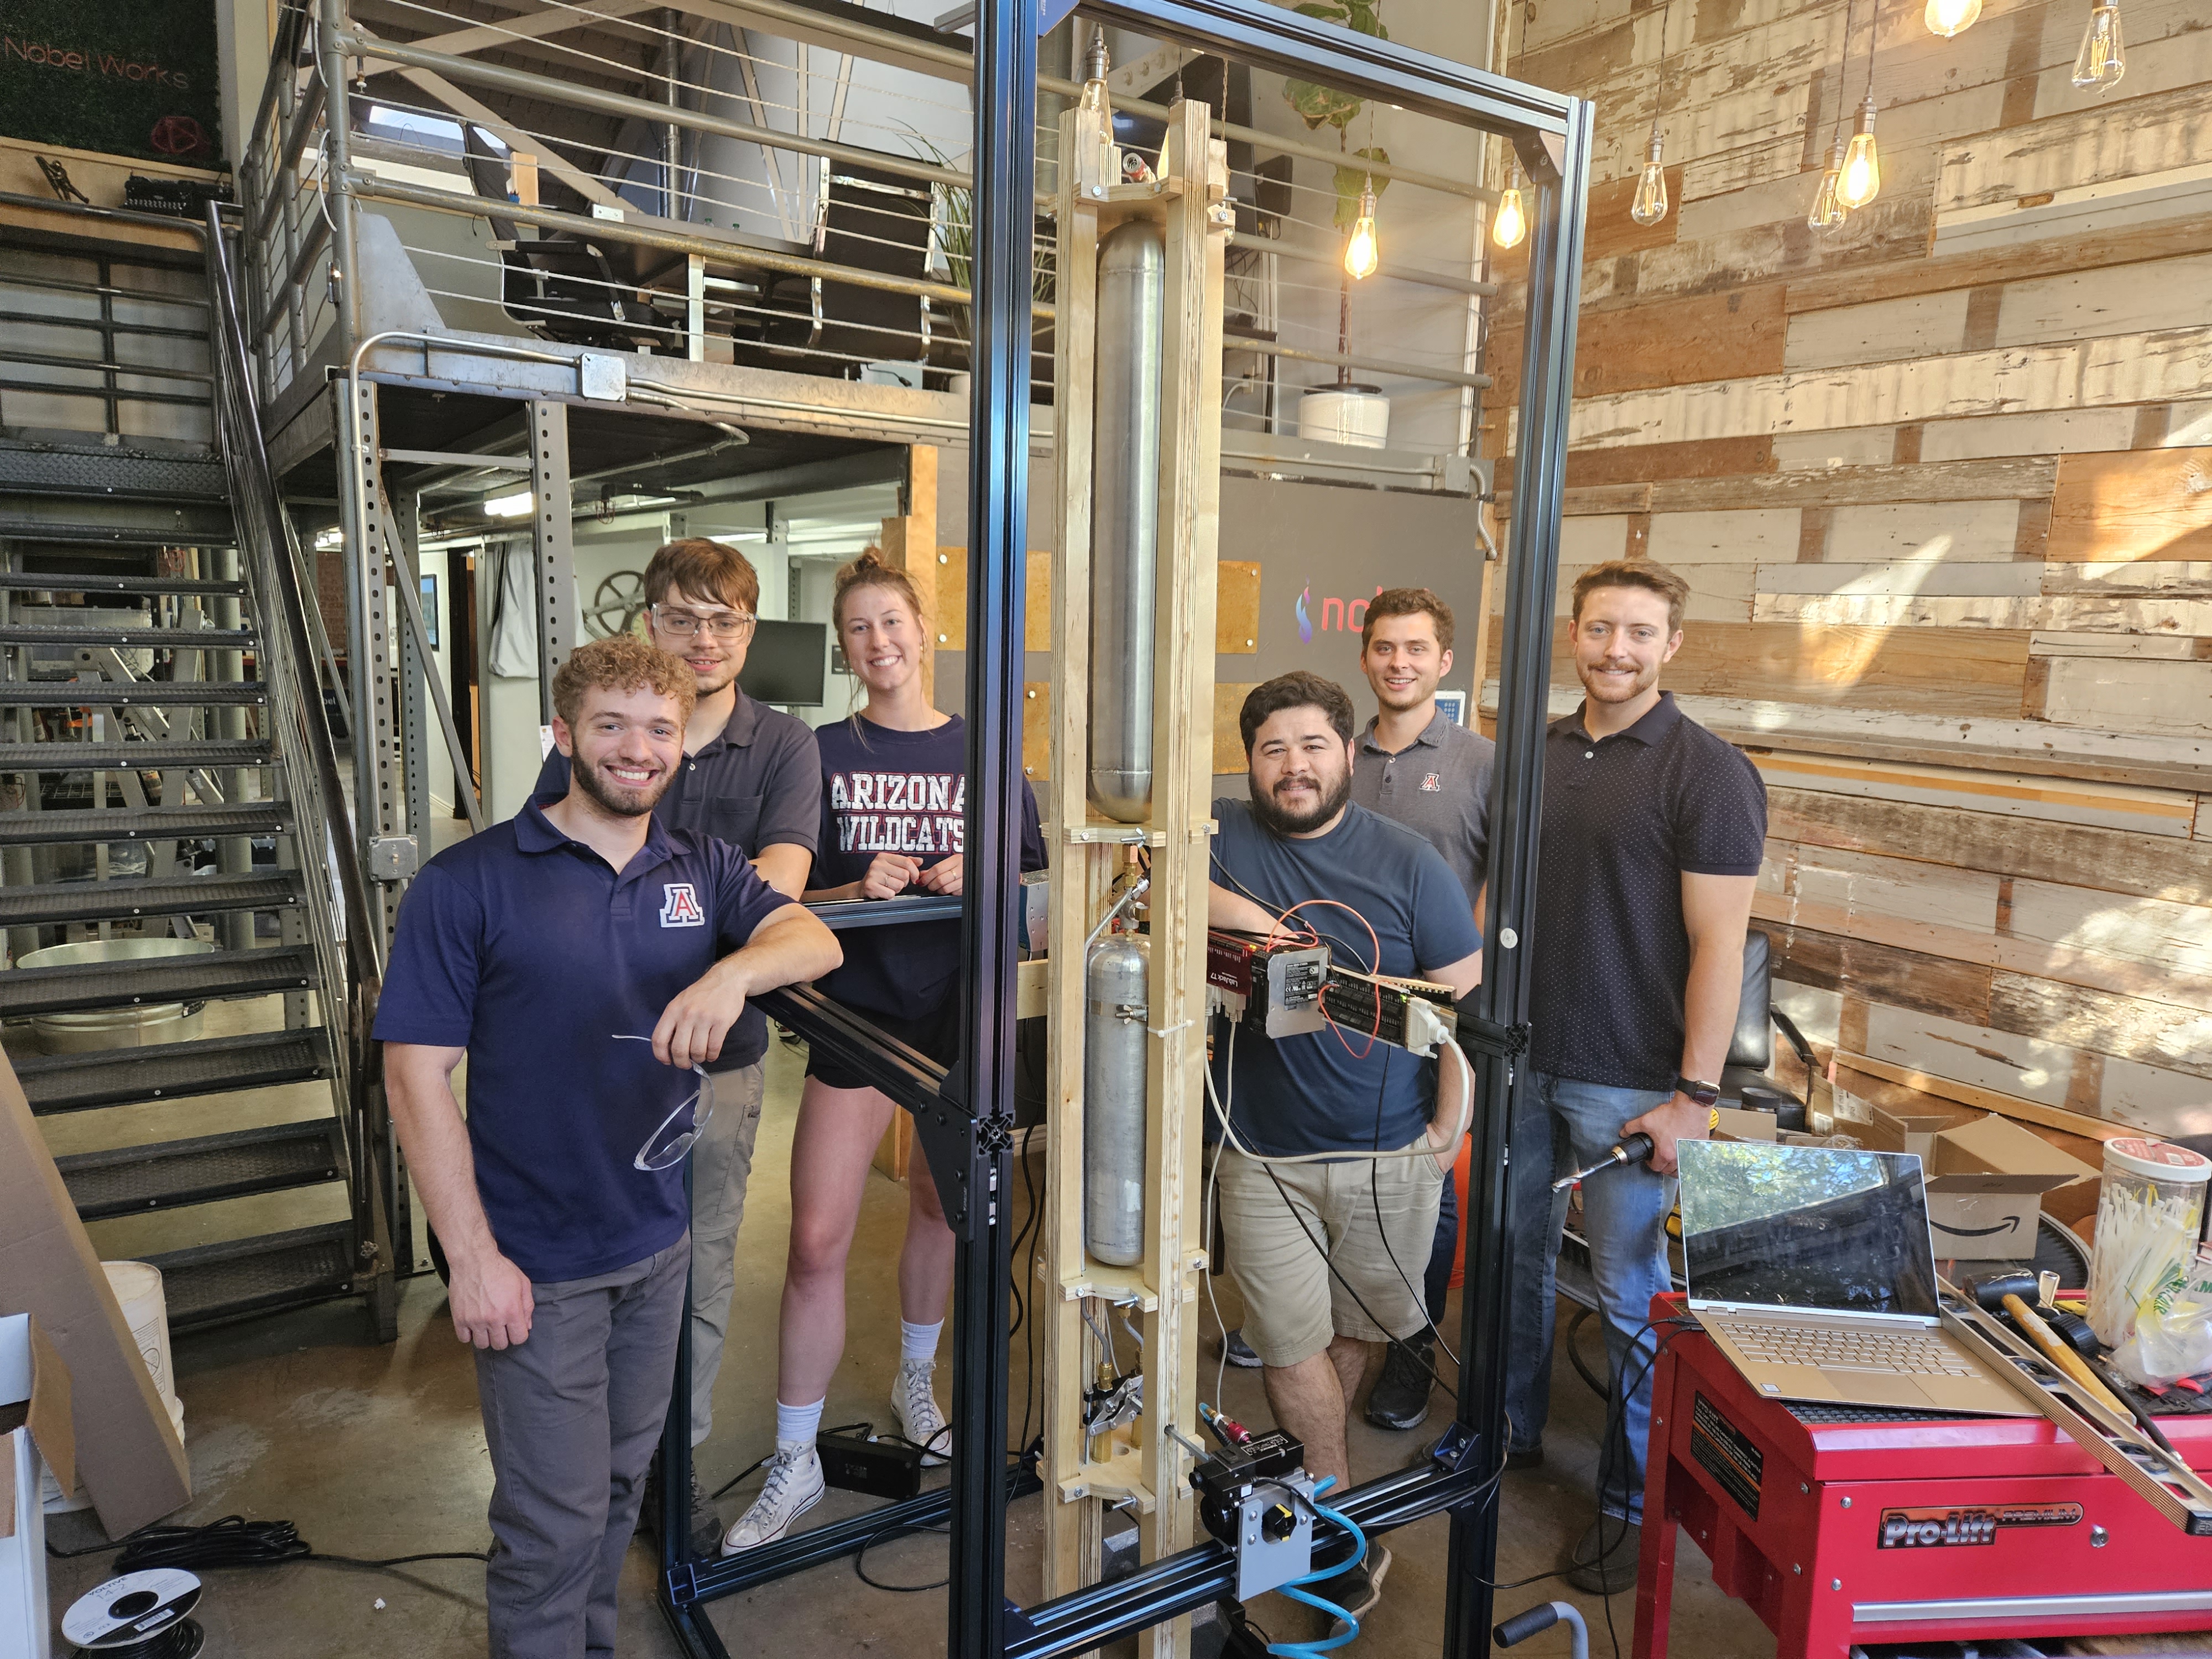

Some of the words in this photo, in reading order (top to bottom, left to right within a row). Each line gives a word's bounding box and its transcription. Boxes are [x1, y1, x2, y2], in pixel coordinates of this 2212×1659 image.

[4, 36, 90, 71] Nobel
[98, 54, 190, 88] Works
[836, 816, 964, 852] WILDCATS
[660, 884, 704, 927] A
[1210, 972, 1217, 980] T7
[1217, 974, 1238, 988] LabJack
[1884, 1512, 1996, 1547] Pro-Lift
[2002, 1509, 2076, 1522] PREMIUM
[88, 1576, 128, 1596] VOLTIVE
